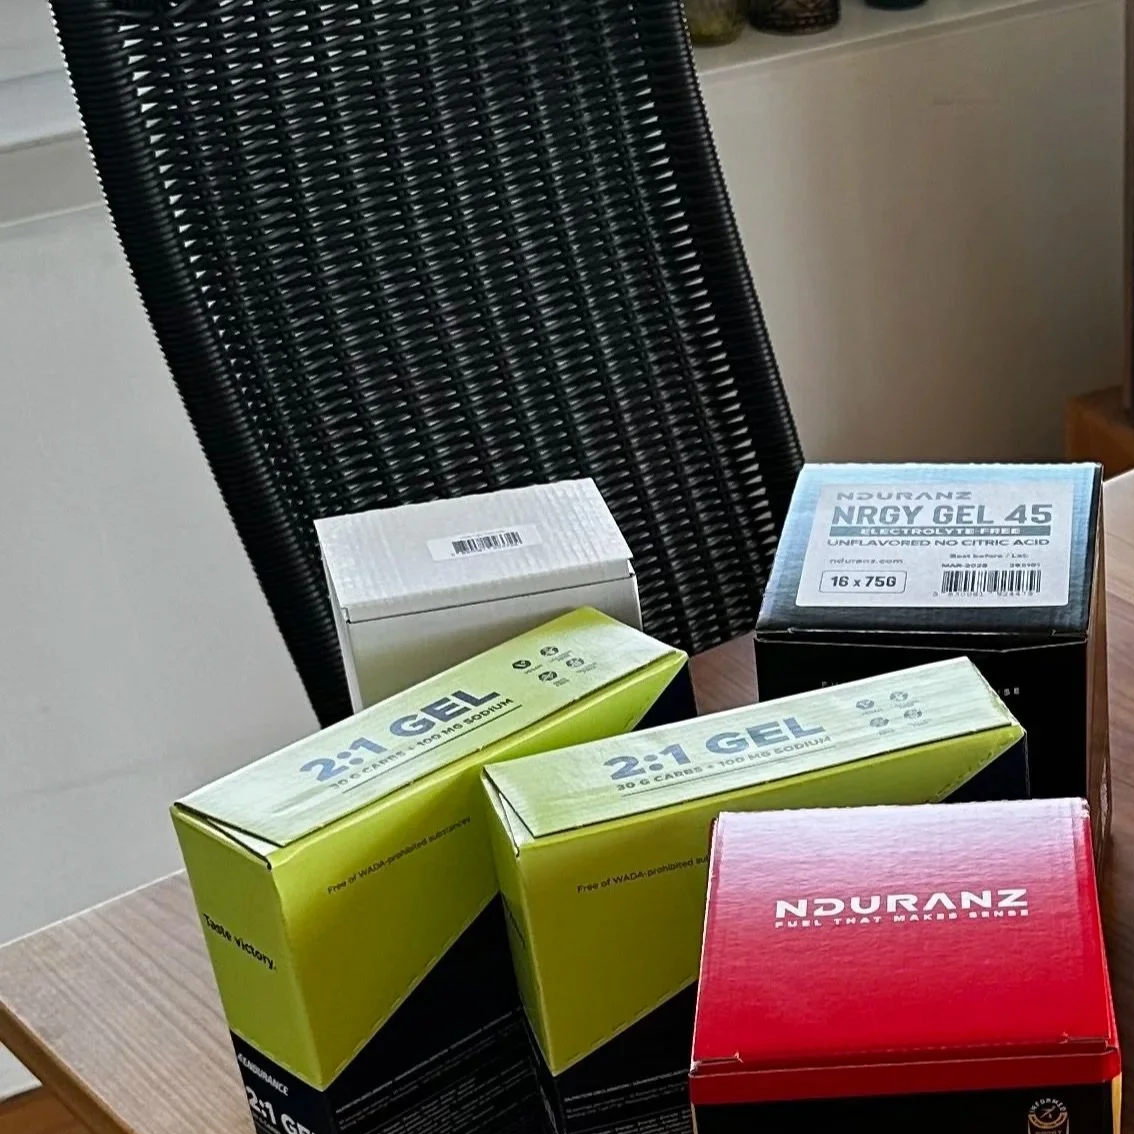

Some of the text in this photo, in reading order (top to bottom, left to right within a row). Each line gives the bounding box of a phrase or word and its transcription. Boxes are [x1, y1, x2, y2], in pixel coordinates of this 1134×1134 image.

[836, 491, 972, 501] NDURANZ
[831, 504, 1053, 525] NRGY GEL 45
[827, 539, 930, 547] UNFLAVORED
[934, 539, 959, 547] NO
[860, 527, 975, 536] ELECTROLYTE
[831, 576, 897, 587] 16 x 75G
[463, 697, 514, 726] SODIUM
[300, 690, 501, 782] 2:1 GEL
[604, 744, 691, 780] 2:1
[706, 717, 826, 755] GEL
[617, 736, 831, 792] 30 CARBS 100 MG SODIUM
[328, 874, 357, 894] Free of
[577, 858, 694, 893] Free of WADA-prohibited
[775, 888, 1028, 918] NDURANZ
[203, 913, 232, 941] Taste
[775, 909, 1029, 928] FUEL THAT MAKES SENSE
[245, 1086, 276, 1126] 2:1
